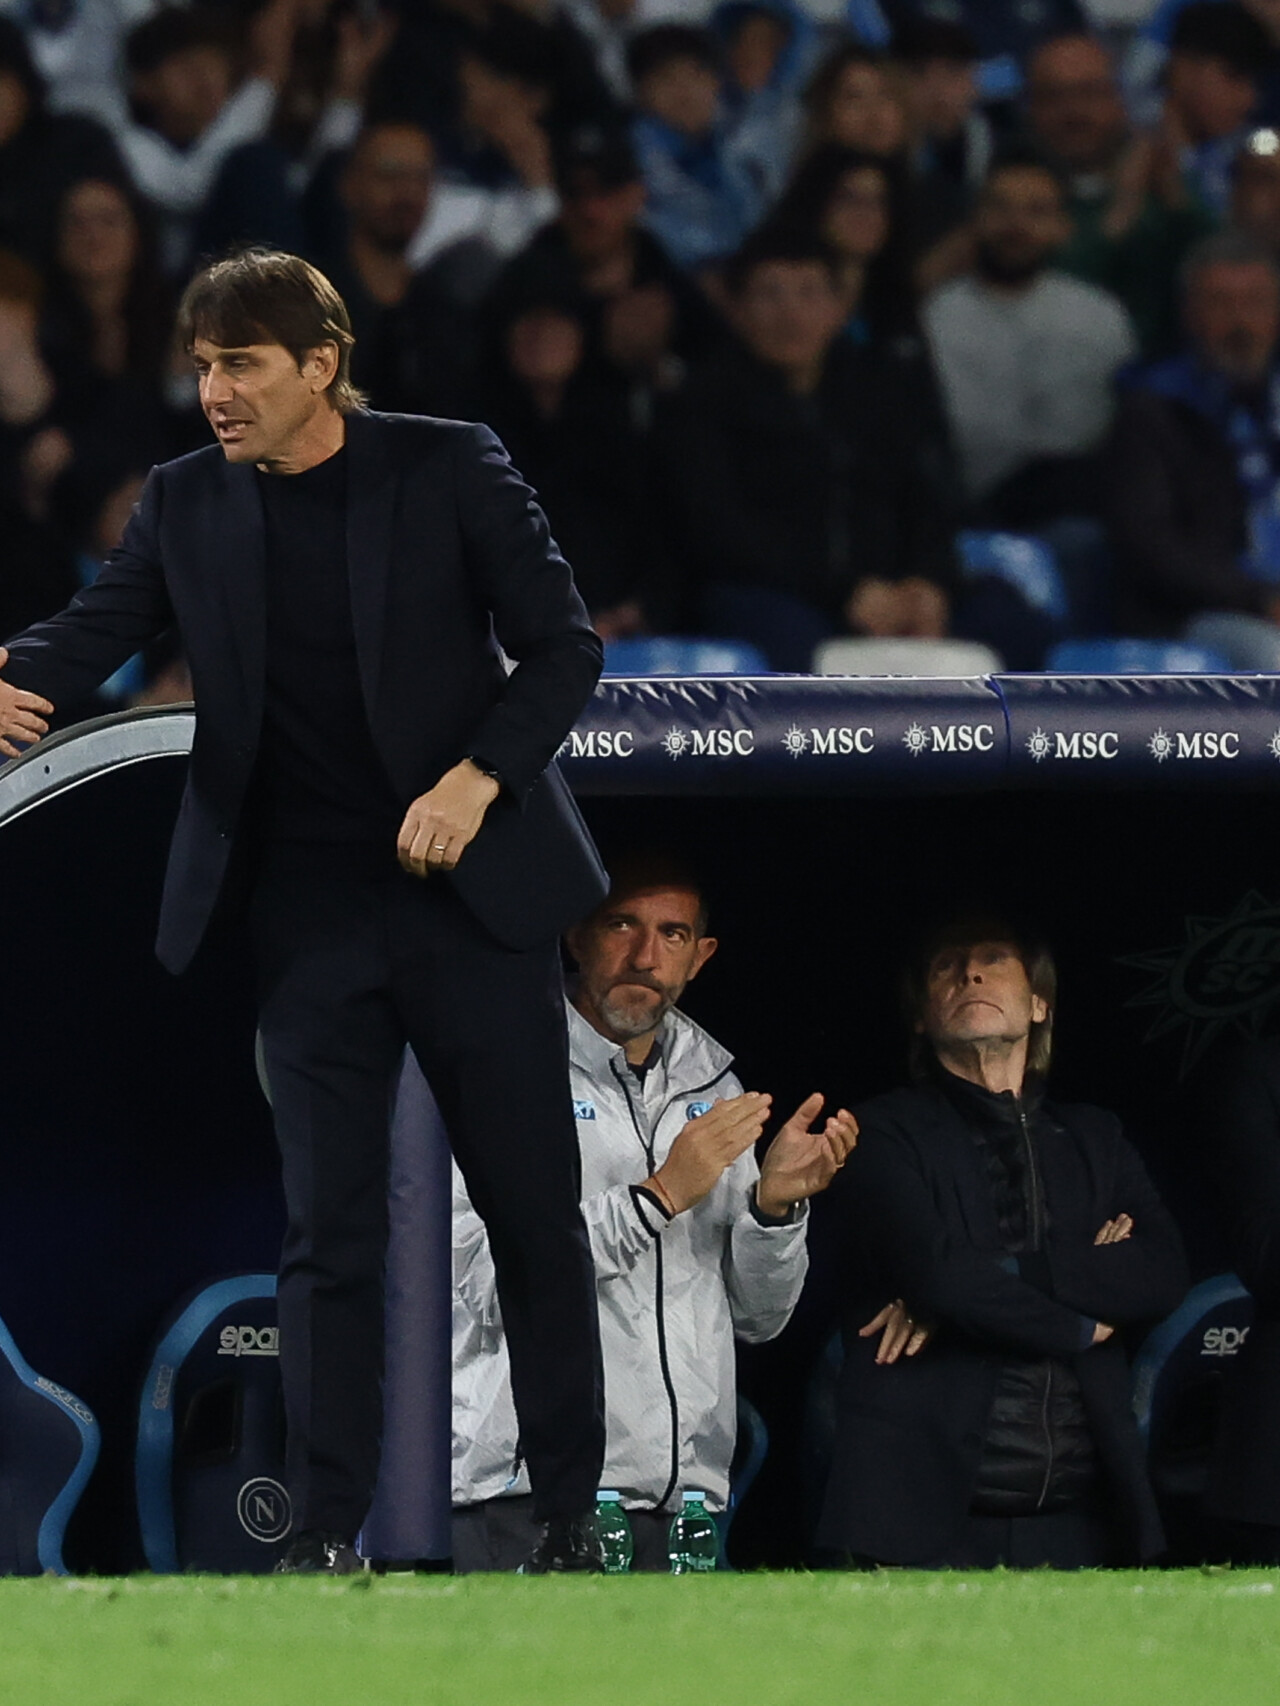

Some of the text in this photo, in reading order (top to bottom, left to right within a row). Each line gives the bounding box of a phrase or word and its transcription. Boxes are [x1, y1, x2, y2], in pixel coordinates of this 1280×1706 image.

[570, 731, 633, 757] MSC
[691, 729, 754, 755] MSC
[811, 727, 874, 754] MSC
[931, 725, 994, 752] MSC
[1054, 732, 1119, 759] MSC
[1176, 732, 1240, 759] MSC
